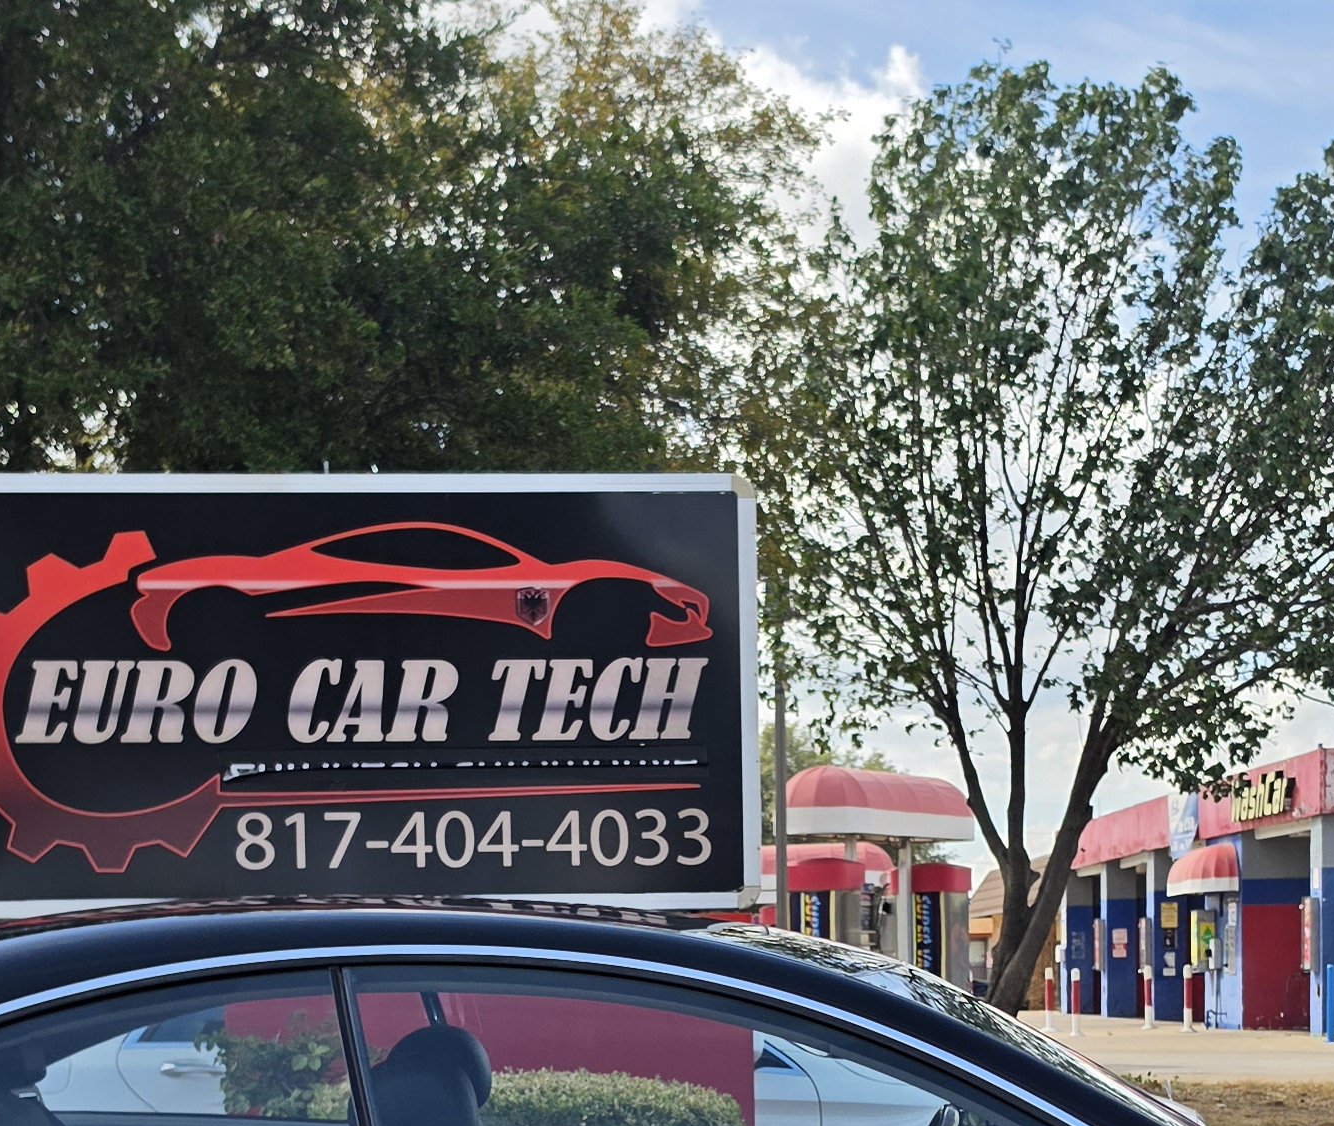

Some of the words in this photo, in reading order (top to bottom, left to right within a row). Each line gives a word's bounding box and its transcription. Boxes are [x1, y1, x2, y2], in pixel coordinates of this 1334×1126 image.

[15, 658, 259, 746] EURO
[287, 658, 460, 746] CAR
[489, 656, 710, 745] TECH
[234, 808, 713, 872] 817-404-4033
